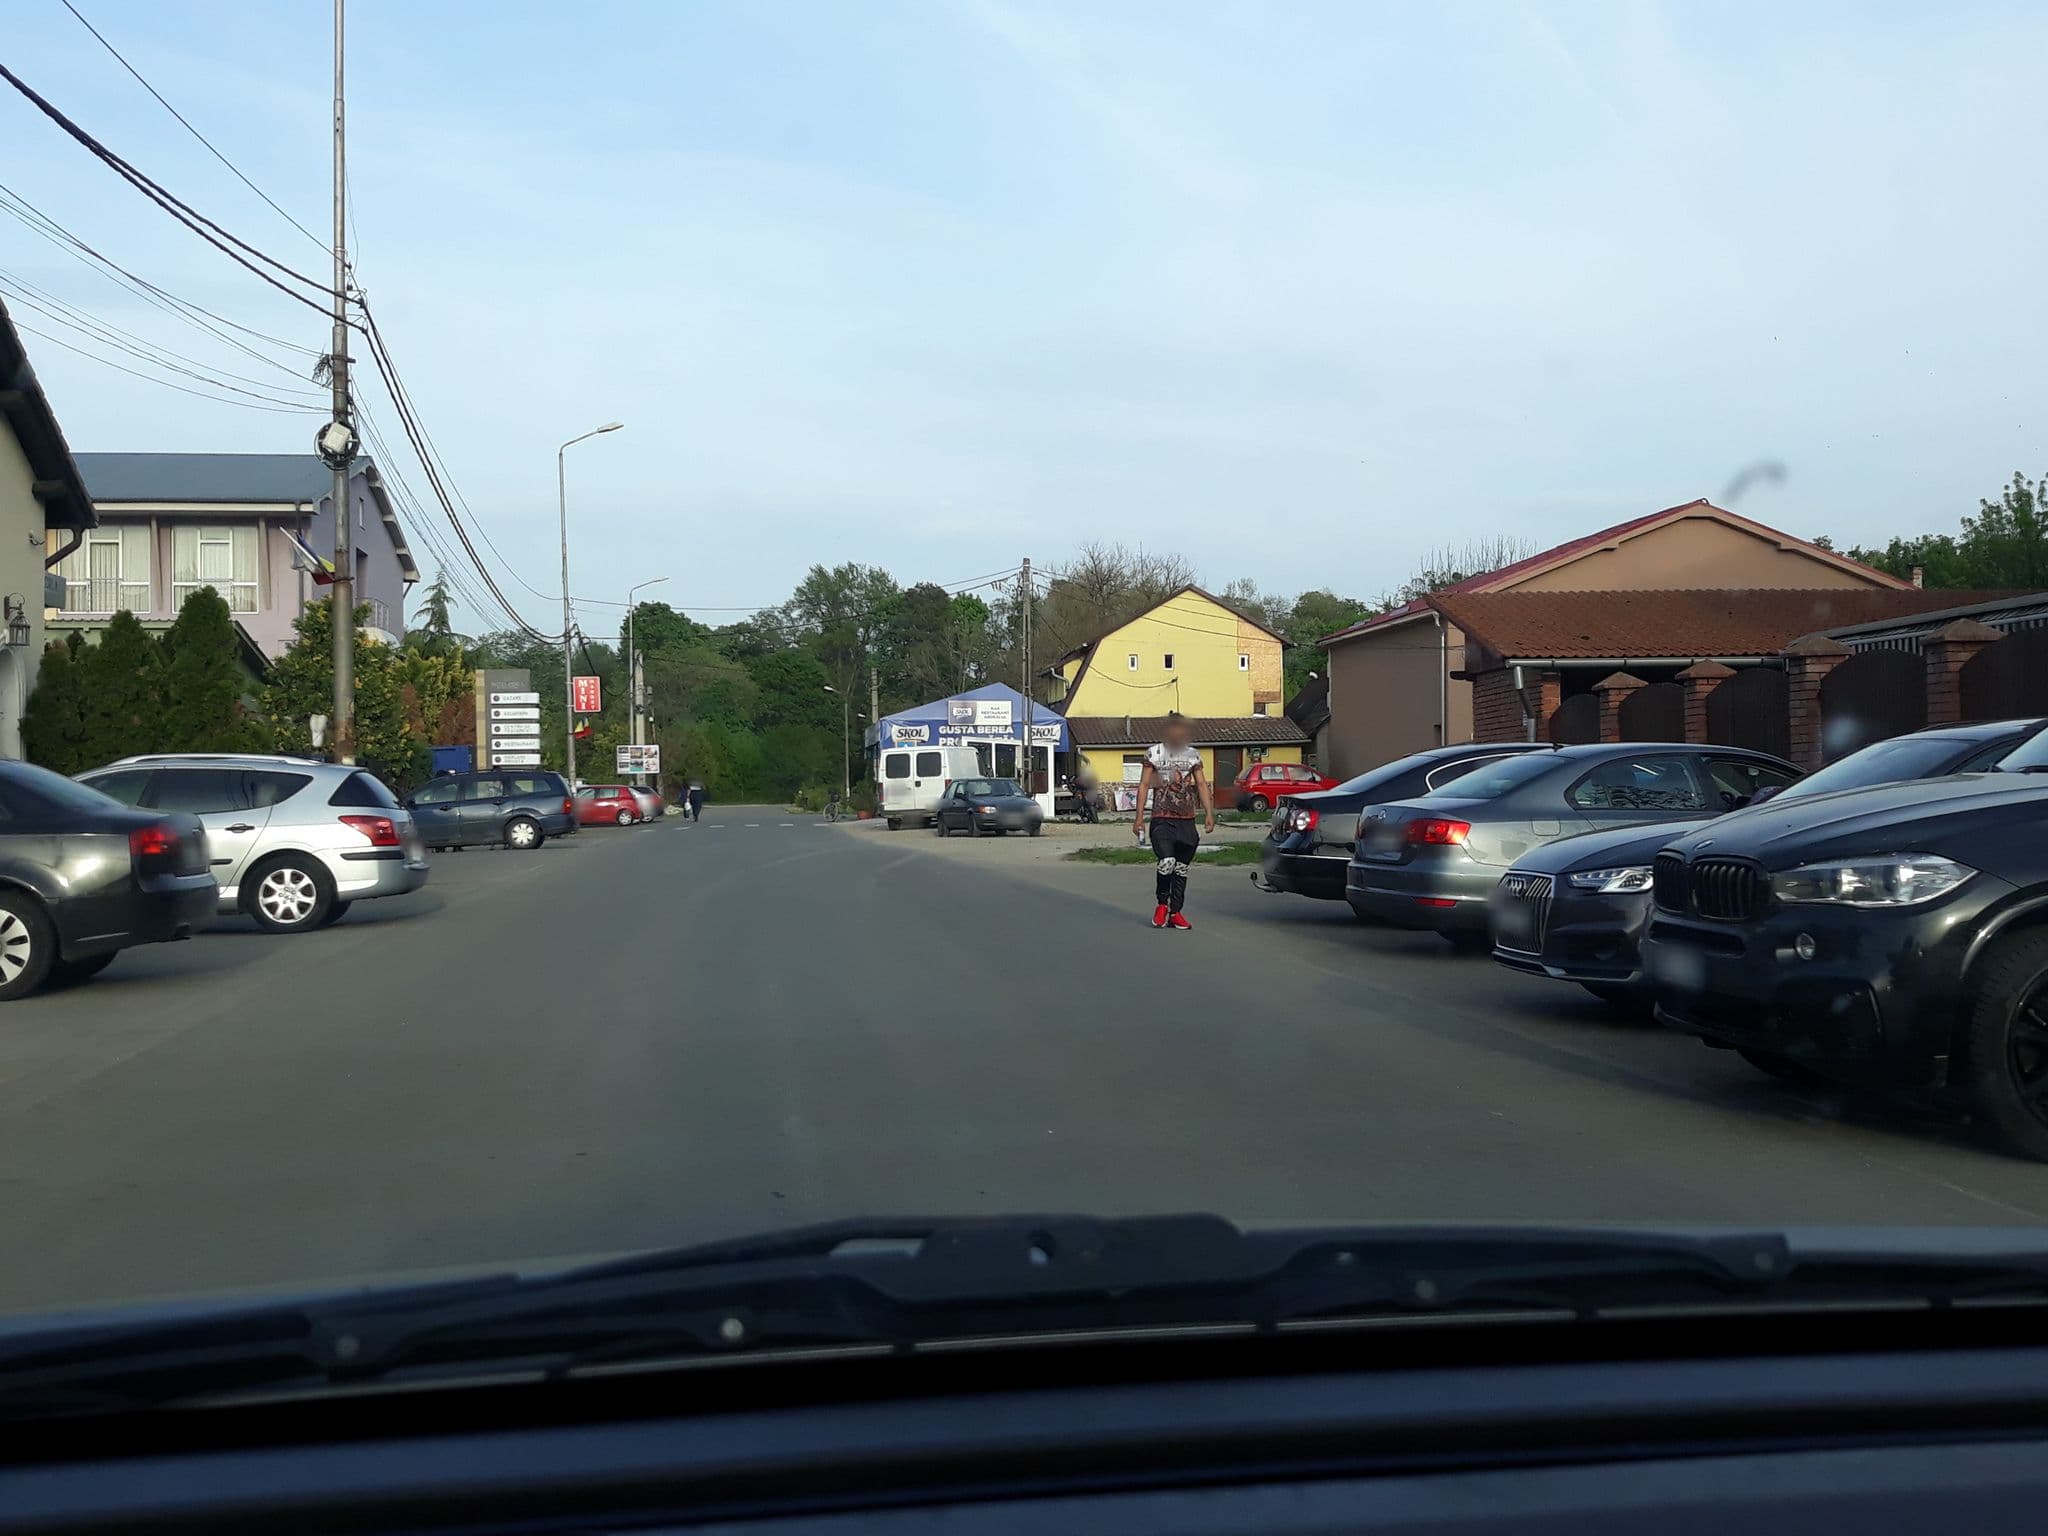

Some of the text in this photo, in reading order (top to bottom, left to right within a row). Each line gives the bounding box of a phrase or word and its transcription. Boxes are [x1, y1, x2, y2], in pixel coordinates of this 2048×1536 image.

[578, 679, 588, 710] MINI
[896, 728, 925, 738] SKOL
[938, 726, 1014, 734] GUSTA BEREA
[1031, 727, 1057, 737] SKOL
